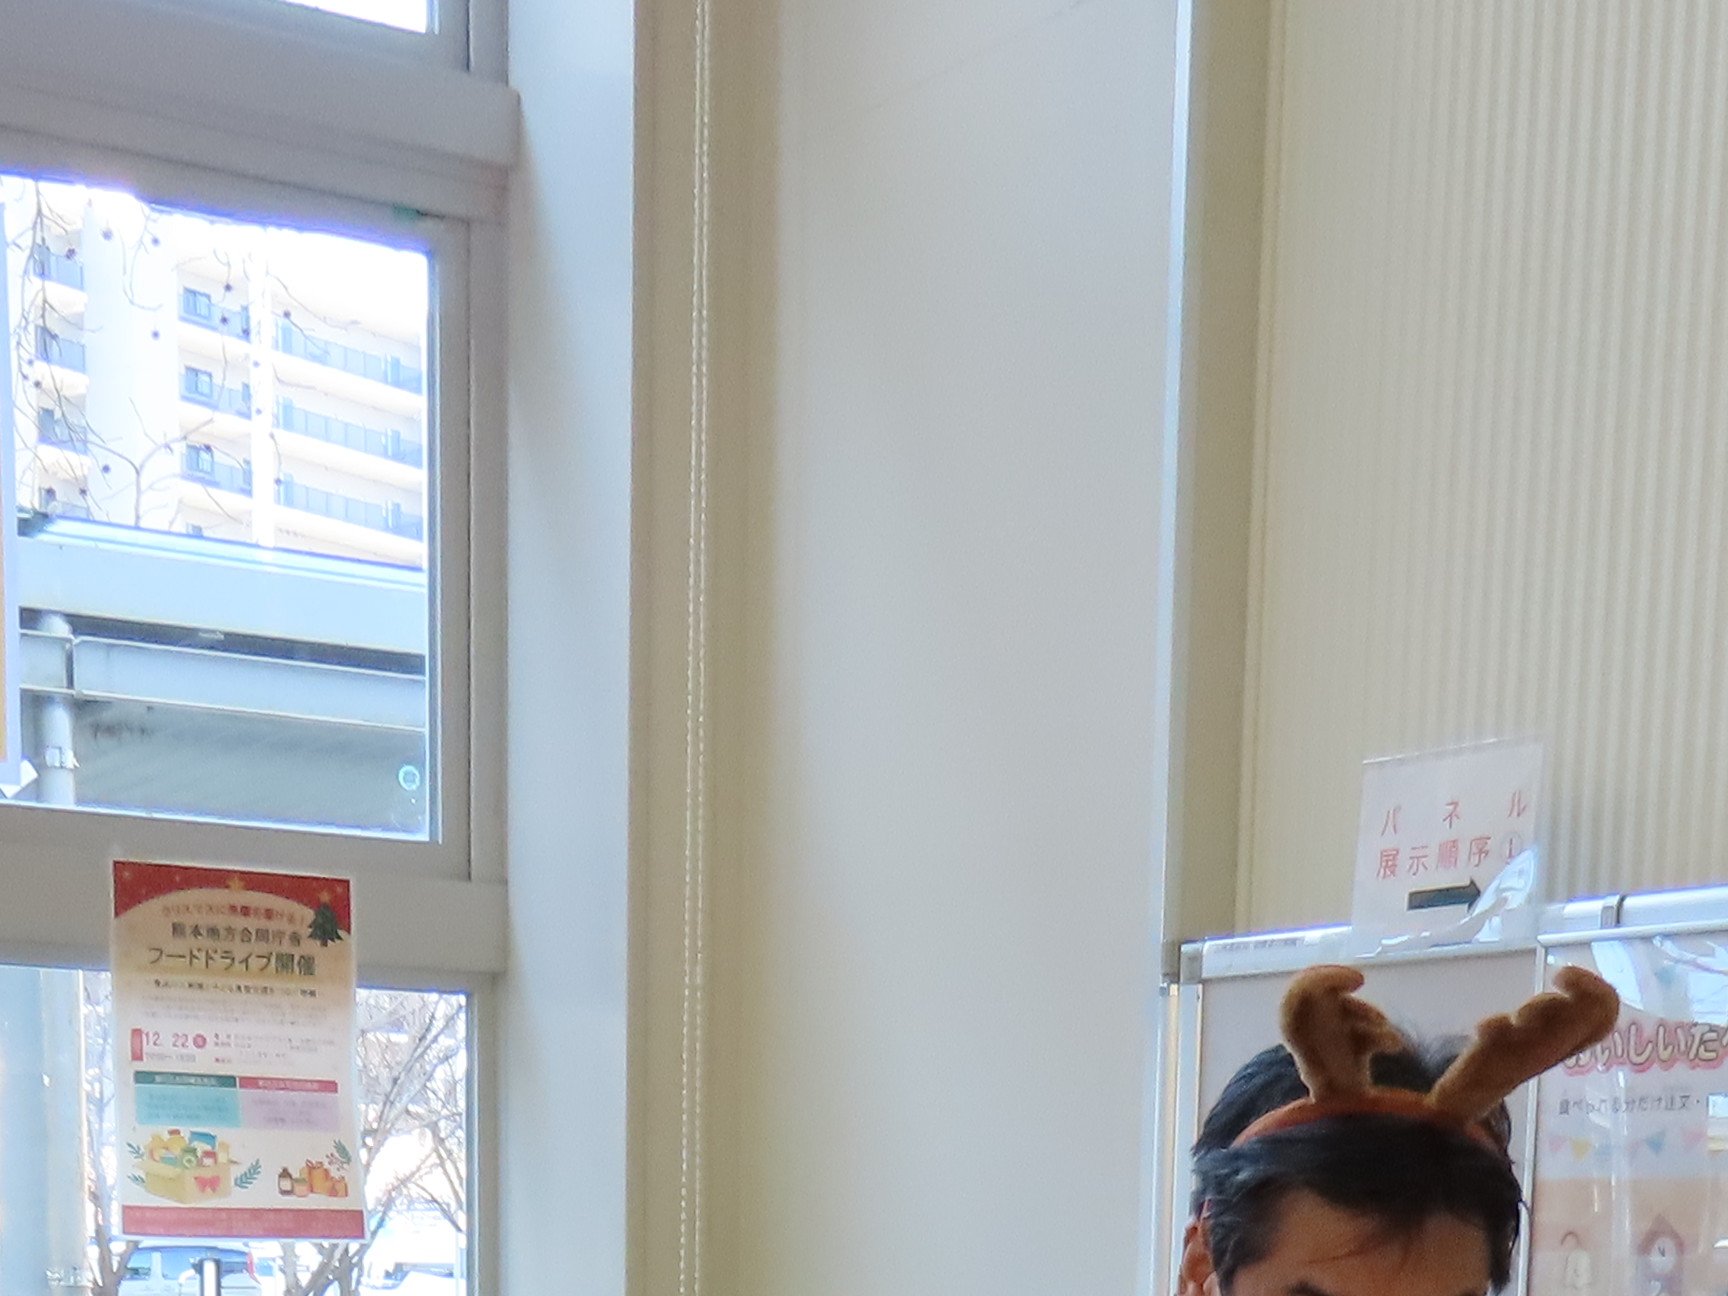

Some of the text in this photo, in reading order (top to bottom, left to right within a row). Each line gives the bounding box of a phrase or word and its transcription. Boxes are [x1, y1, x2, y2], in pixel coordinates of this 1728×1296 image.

[149, 948, 316, 976] フードドライブ開催
